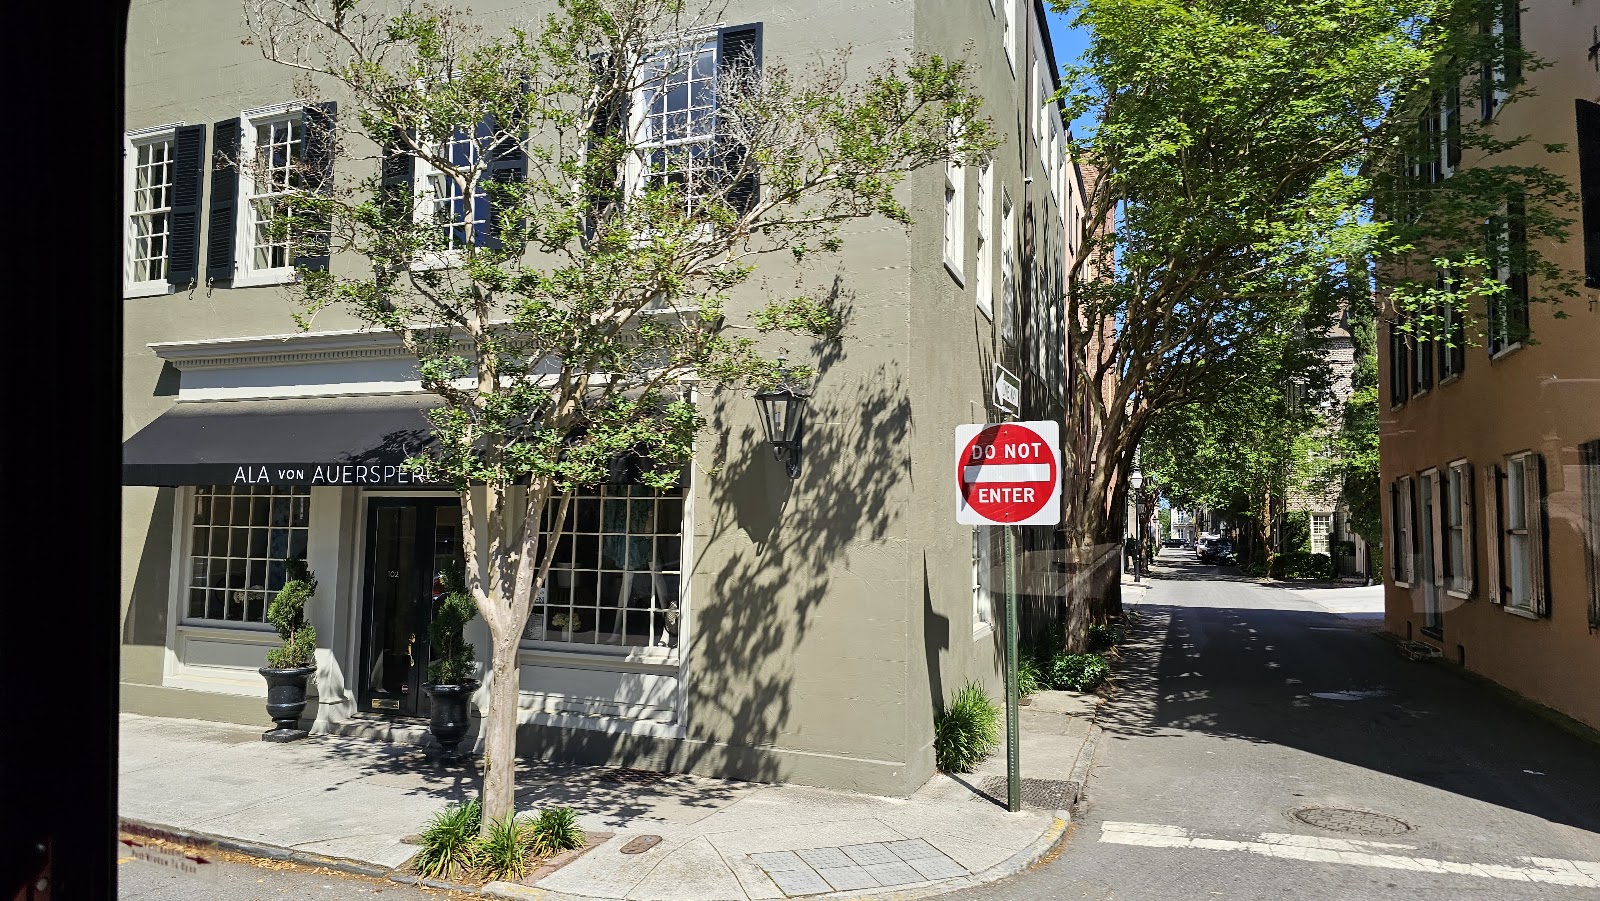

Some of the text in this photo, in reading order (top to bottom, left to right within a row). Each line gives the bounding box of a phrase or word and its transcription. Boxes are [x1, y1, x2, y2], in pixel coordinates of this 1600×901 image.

[972, 442, 1042, 460] DO NOT
[233, 465, 270, 483] ALA
[278, 469, 304, 480] VON
[978, 487, 1035, 504] ENTER
[387, 570, 399, 578] 102
